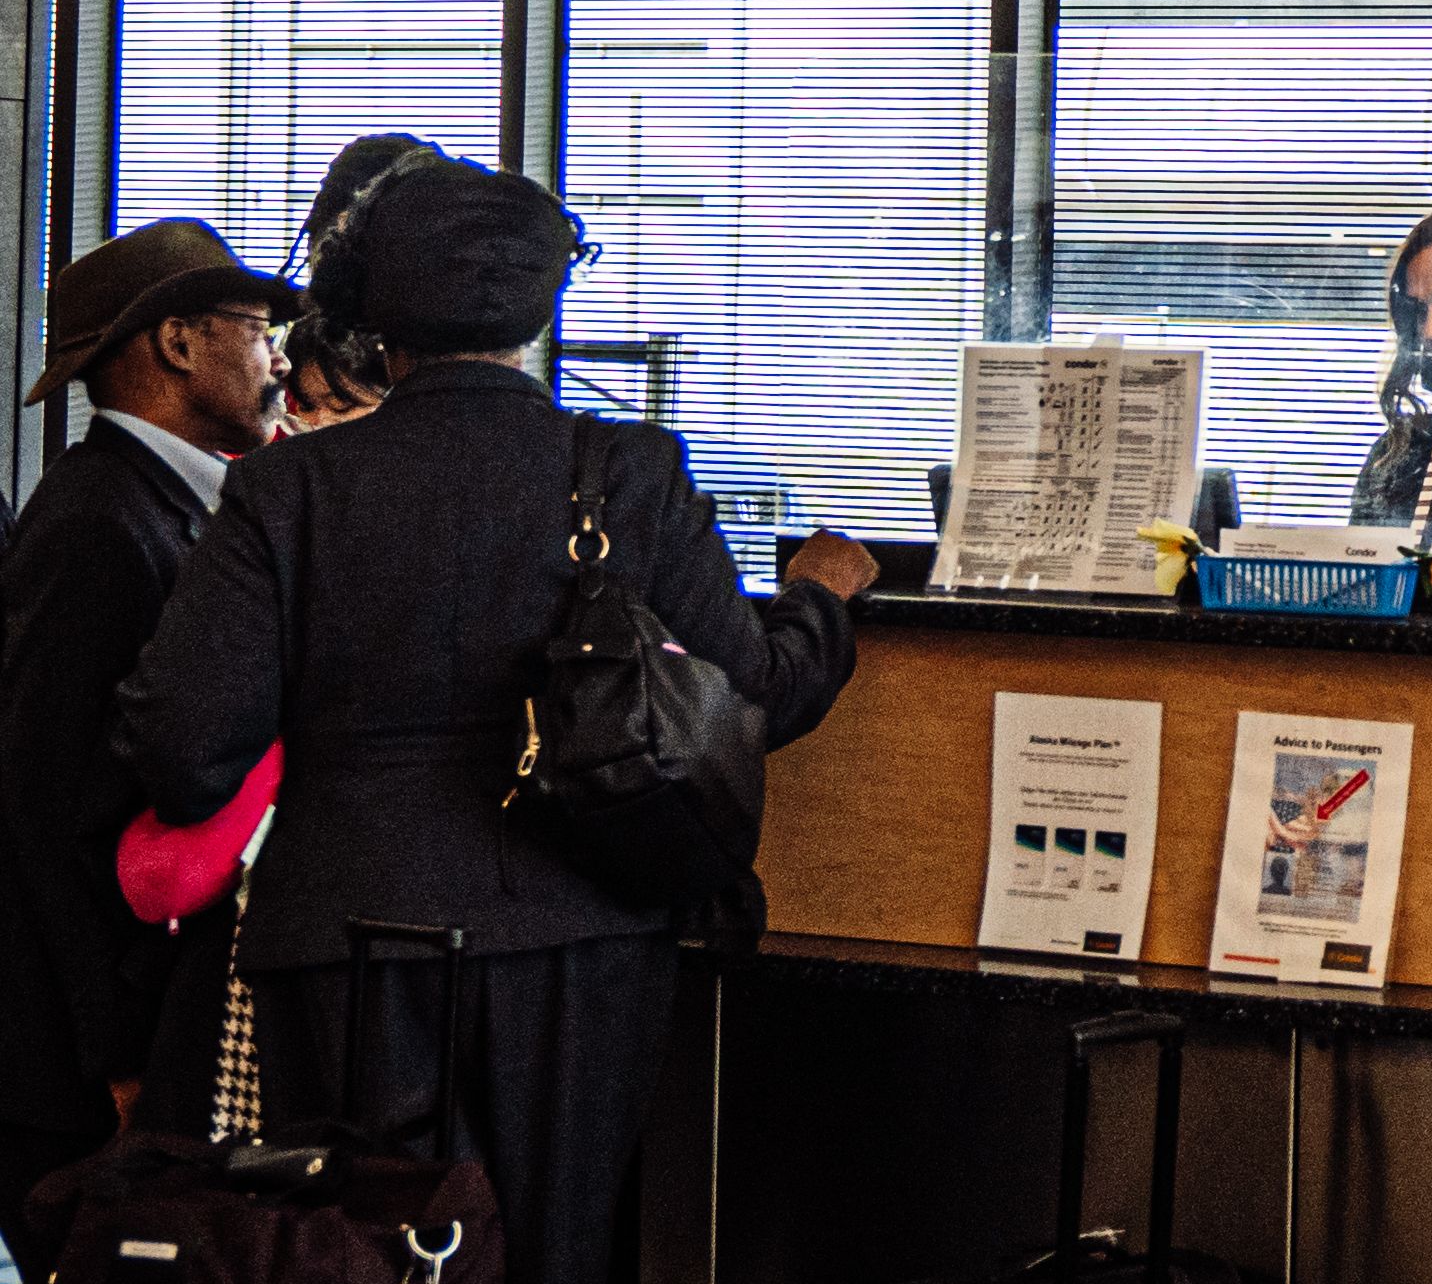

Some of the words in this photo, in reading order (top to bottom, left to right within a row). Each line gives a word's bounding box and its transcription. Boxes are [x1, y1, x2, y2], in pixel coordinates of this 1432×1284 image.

[1345, 546, 1378, 558] Condor
[1273, 734, 1308, 750] Advice
[1311, 737, 1323, 751] to
[1325, 738, 1383, 757] Passengers
